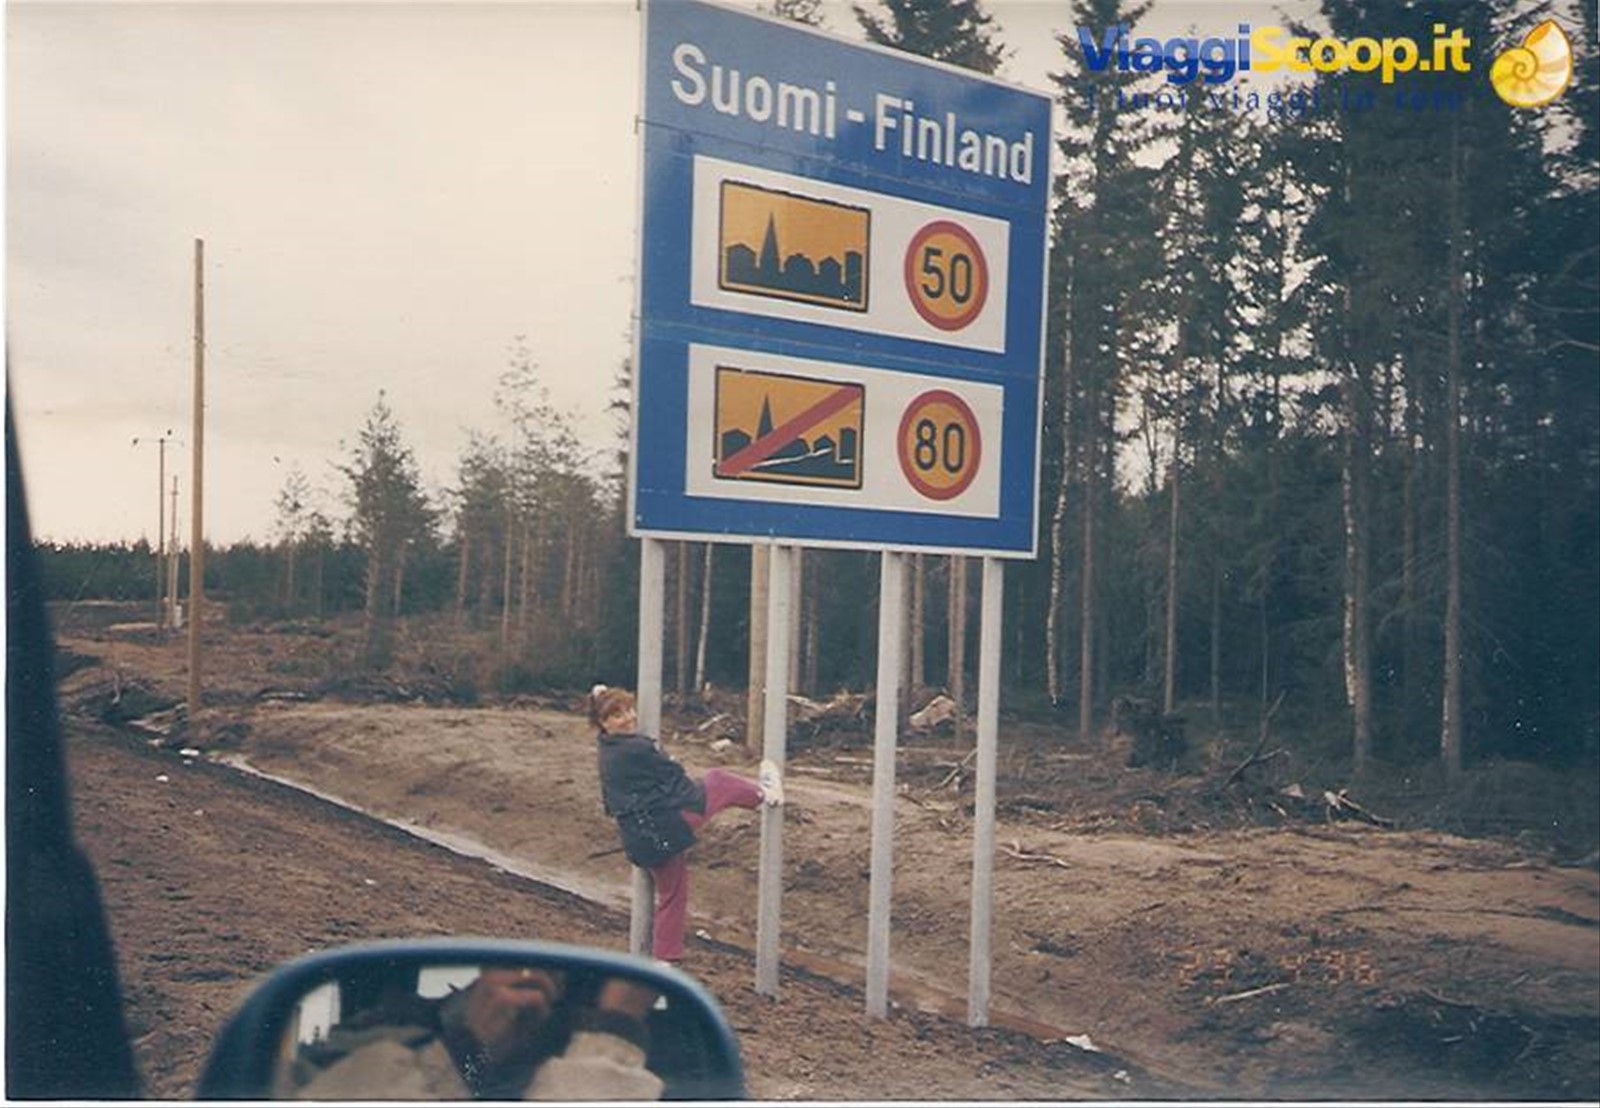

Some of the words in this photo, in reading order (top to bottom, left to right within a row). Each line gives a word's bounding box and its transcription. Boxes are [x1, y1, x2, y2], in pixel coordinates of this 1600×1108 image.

[671, 42, 836, 139] Suomi
[875, 93, 1033, 185] Finland
[922, 247, 973, 305] 50
[915, 418, 965, 474] 80
